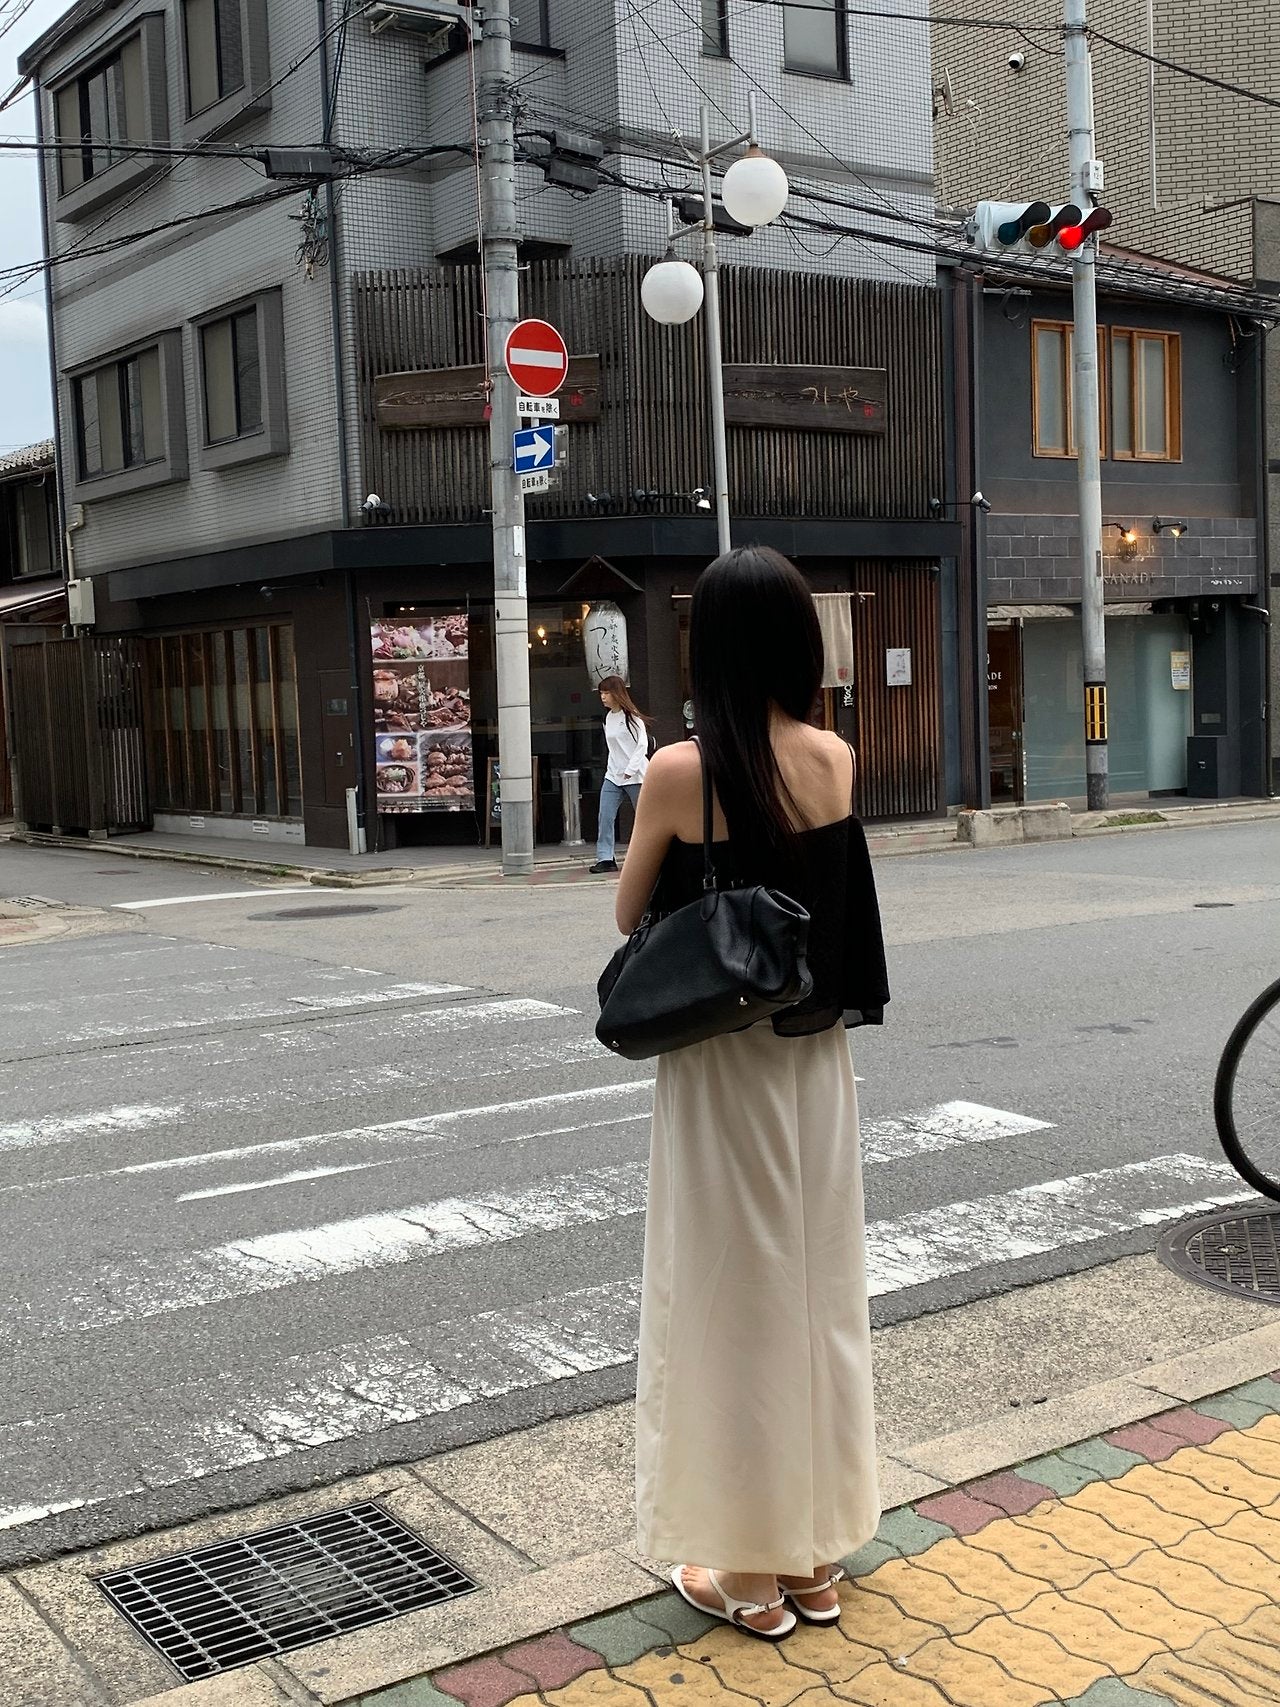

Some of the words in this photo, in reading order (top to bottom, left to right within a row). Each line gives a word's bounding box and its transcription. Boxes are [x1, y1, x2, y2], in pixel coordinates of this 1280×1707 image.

[518, 401, 558, 414] 自転車を除く
[522, 475, 548, 489] 自転車を除く
